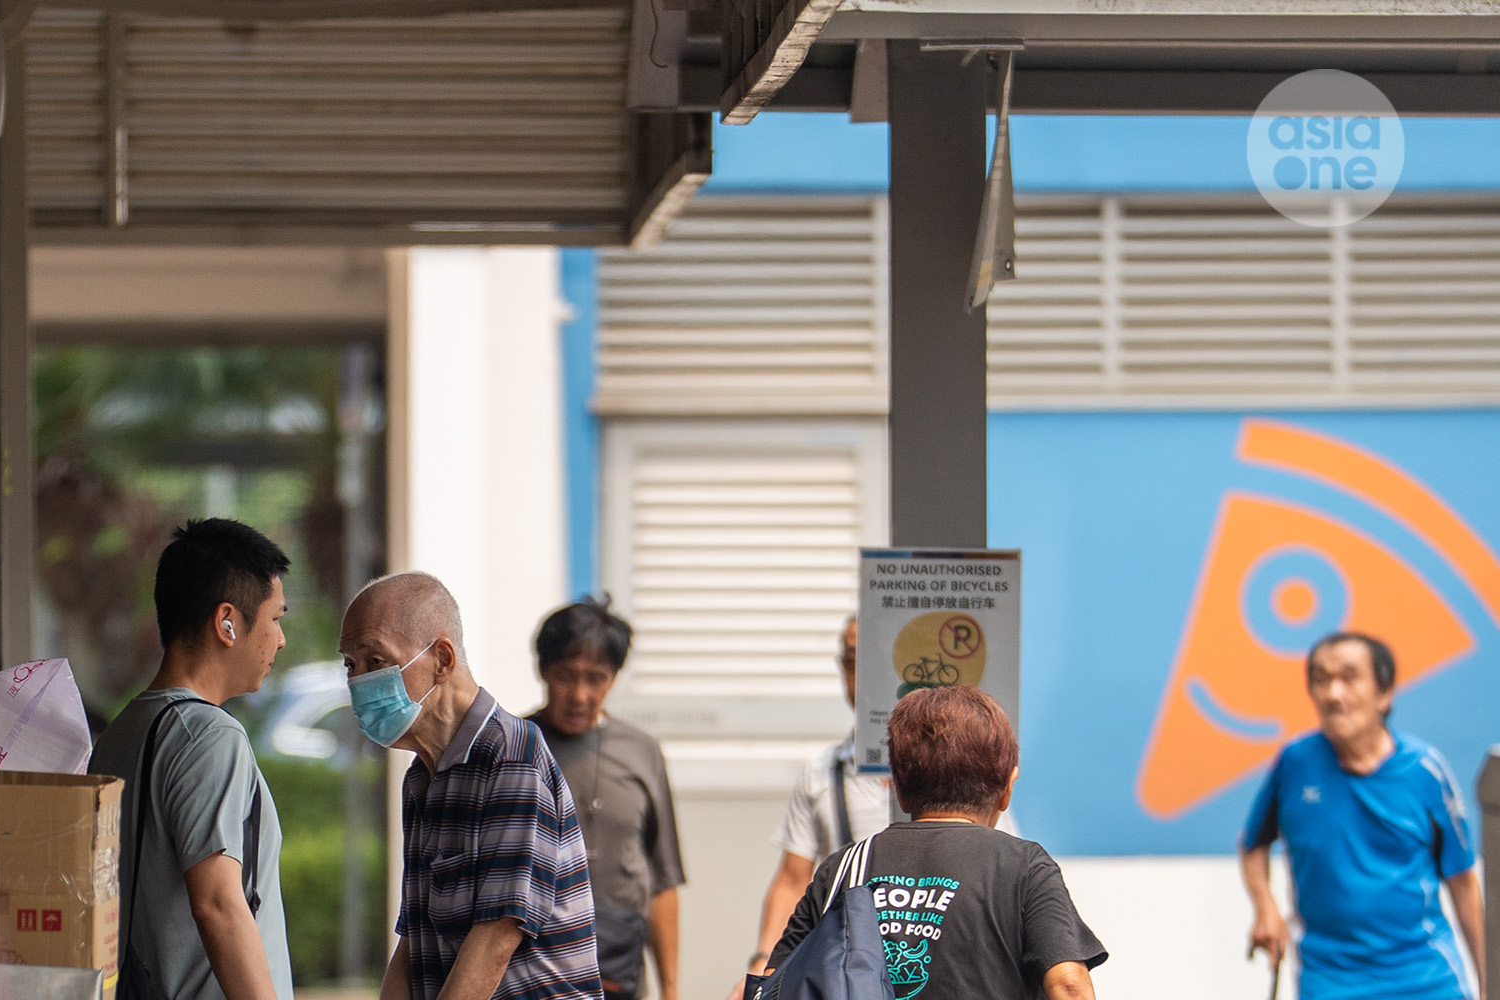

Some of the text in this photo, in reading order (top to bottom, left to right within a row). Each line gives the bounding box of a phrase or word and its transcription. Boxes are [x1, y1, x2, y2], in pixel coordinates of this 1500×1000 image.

[876, 563, 1002, 576] NO UNAUTHORISED
[869, 579, 1008, 591] PARKING OF BICYCLES
[881, 595, 995, 609] 禁止擅自停放自行车
[917, 876, 961, 890] BRINGS
[873, 887, 955, 912] EOPLE
[876, 910, 944, 926] GETHER LIKE
[878, 922, 942, 941] OD FOOD
